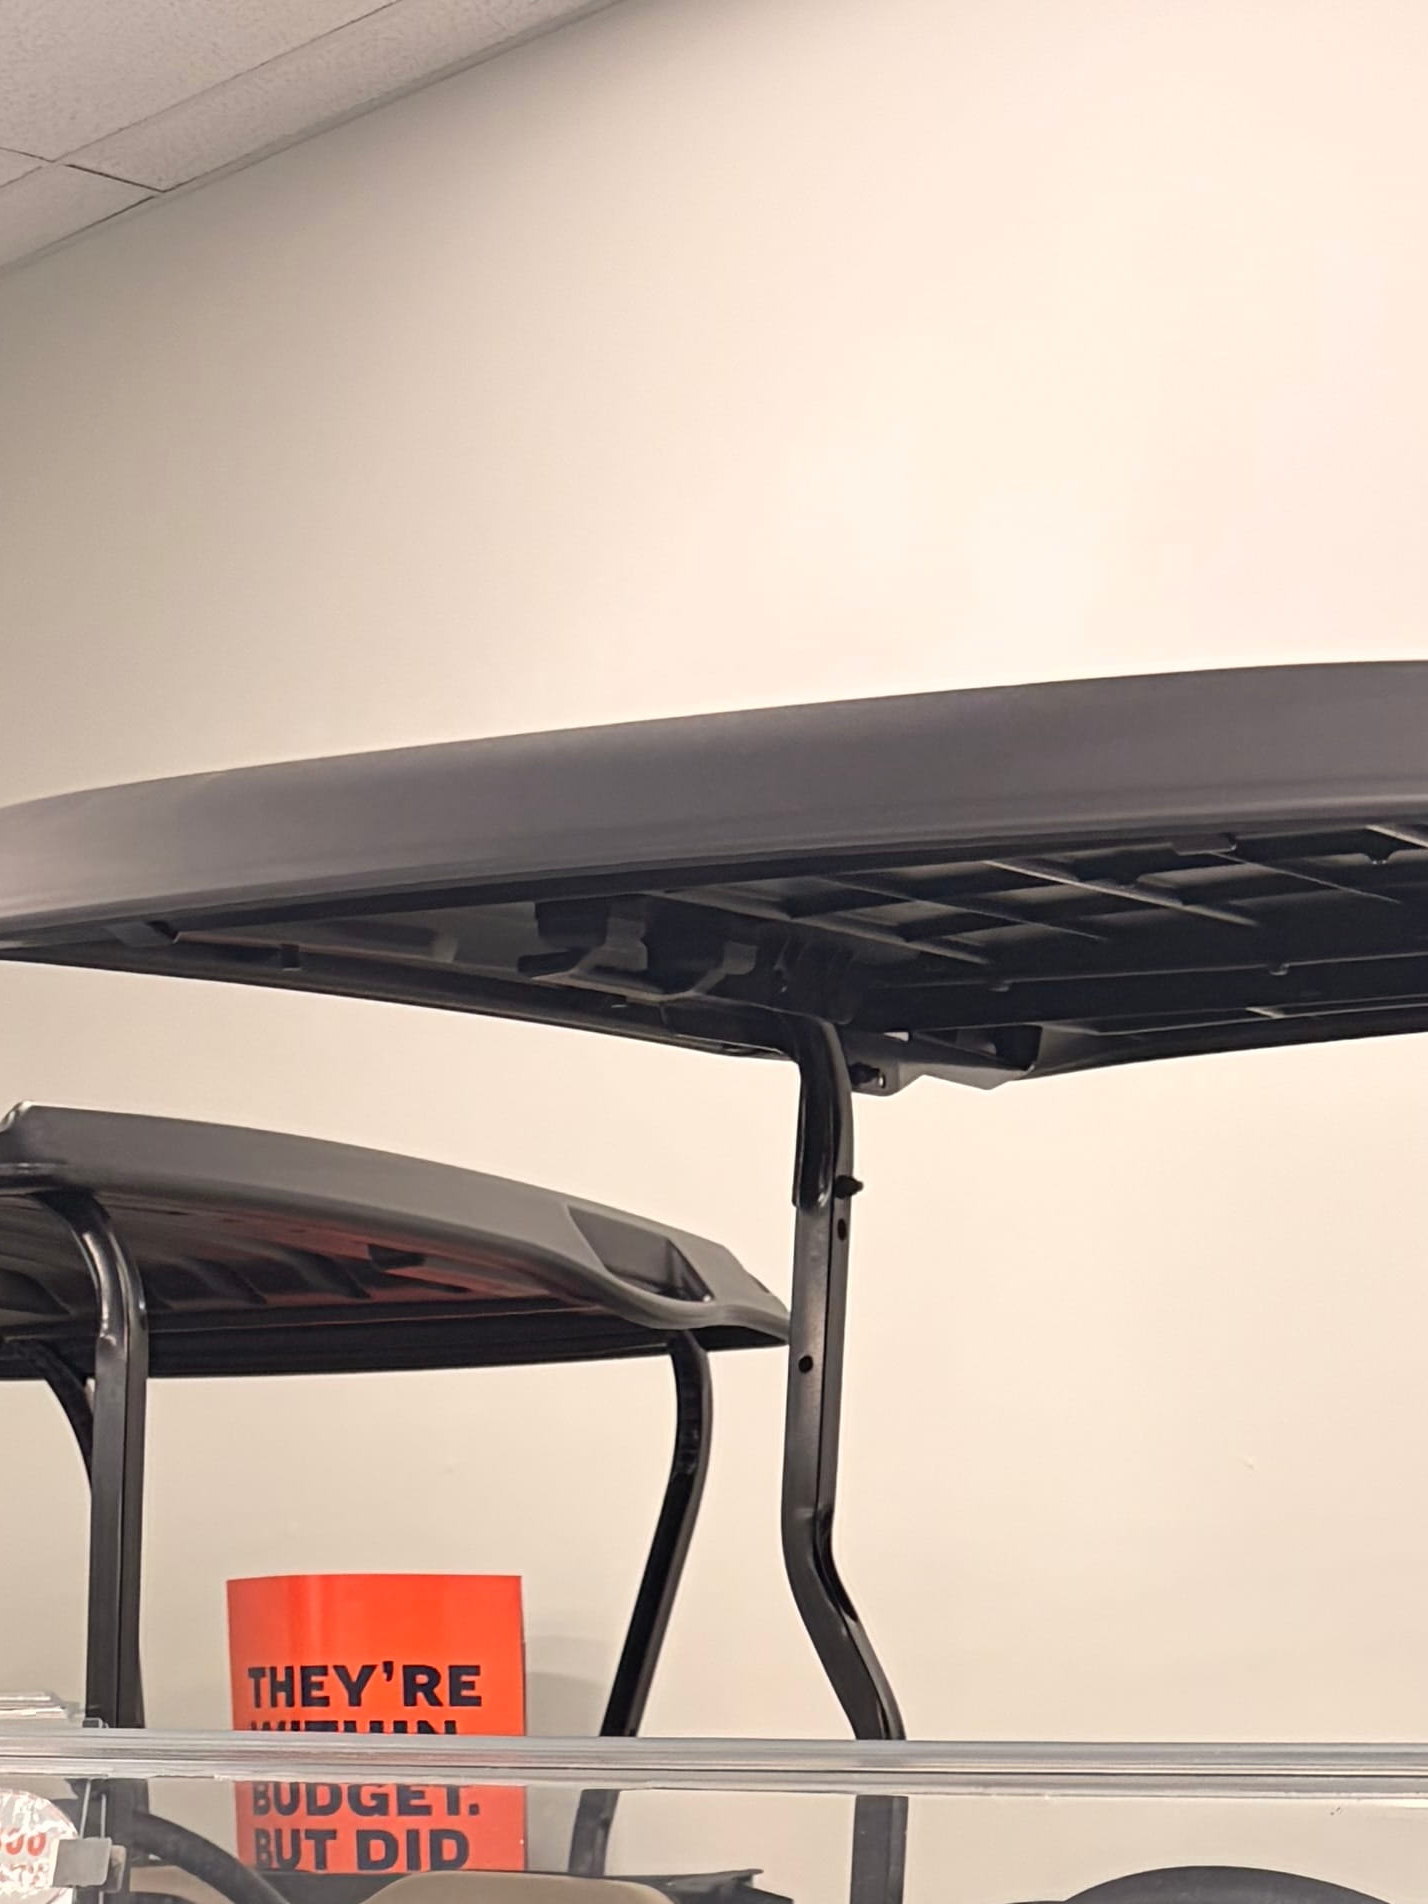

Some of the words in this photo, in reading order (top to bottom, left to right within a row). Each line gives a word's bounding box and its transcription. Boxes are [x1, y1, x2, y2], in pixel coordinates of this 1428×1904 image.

[247, 1660, 483, 1709] THEY'RE
[252, 1781, 481, 1817] BUDGET.
[254, 1828, 338, 1871] BUT
[355, 1829, 470, 1872] DID
